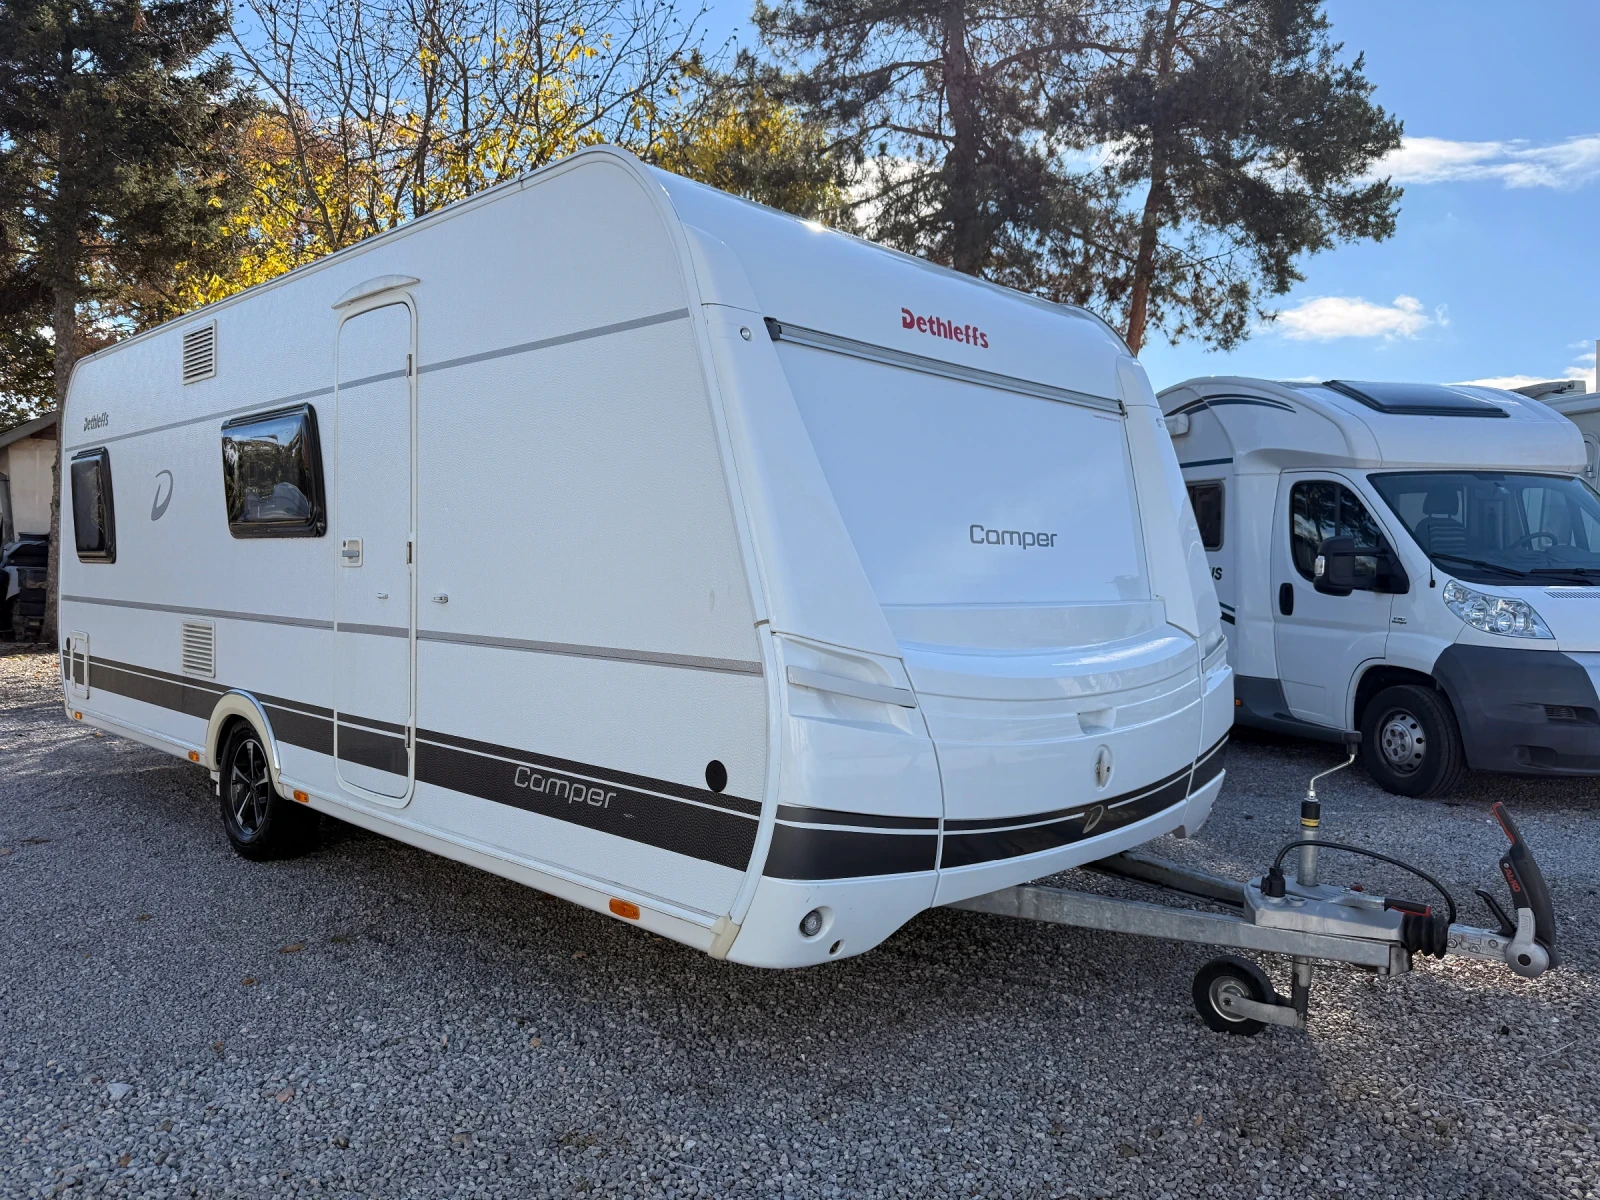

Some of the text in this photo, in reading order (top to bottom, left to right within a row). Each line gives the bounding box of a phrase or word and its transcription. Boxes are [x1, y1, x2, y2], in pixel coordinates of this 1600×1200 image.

[901, 307, 989, 349] Dethleffs
[969, 524, 1058, 550] Camper
[514, 766, 617, 809] Camper
